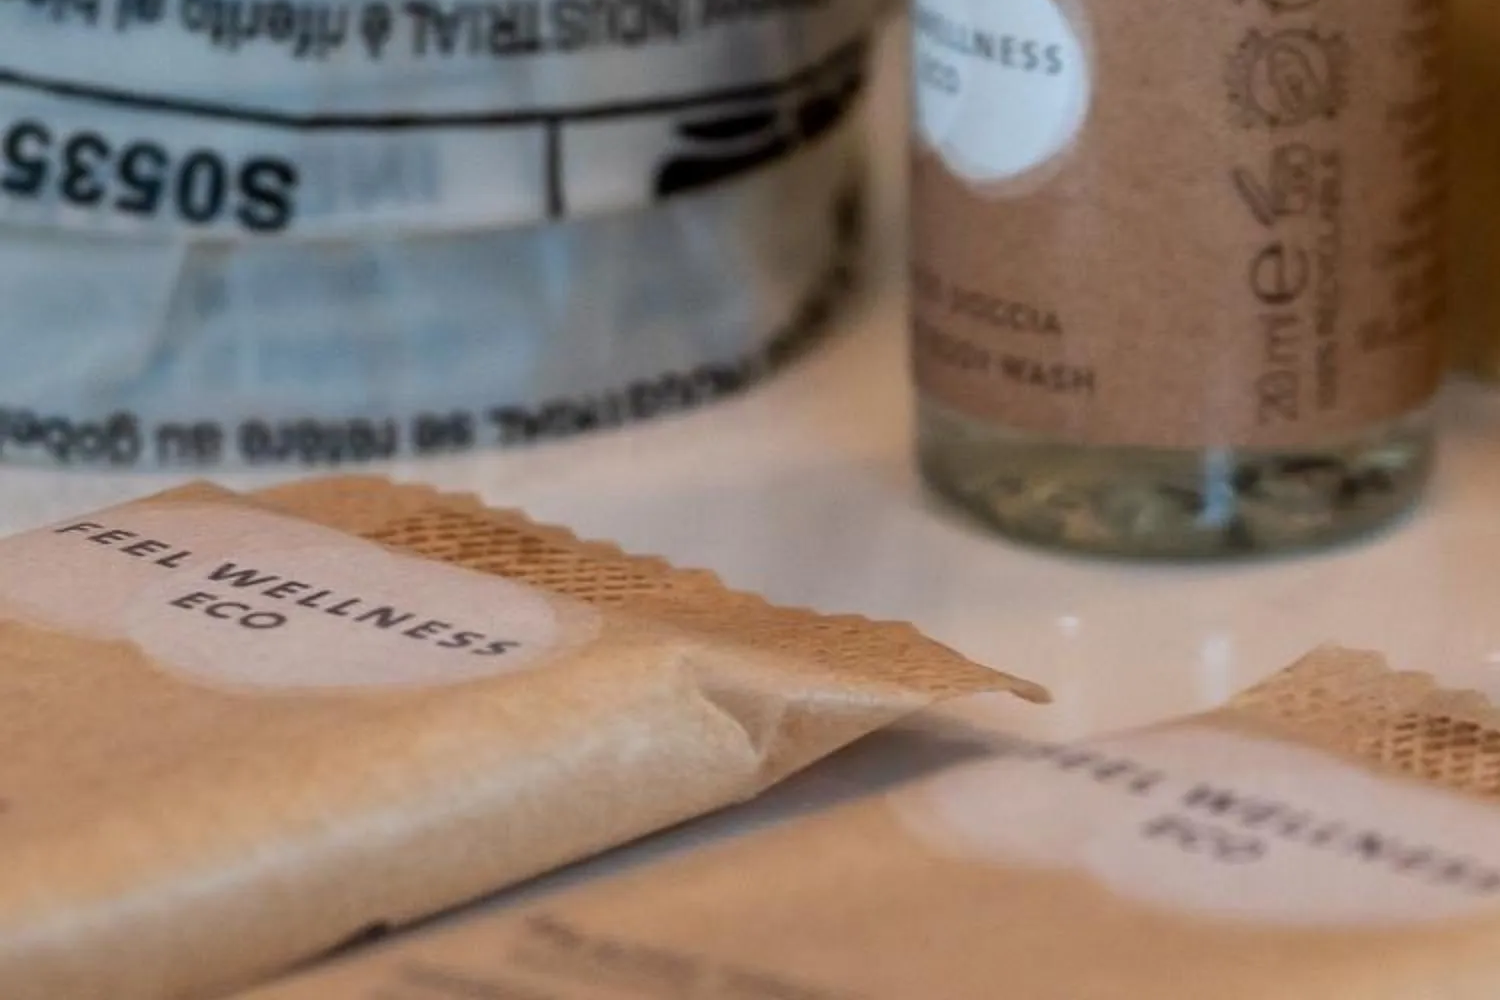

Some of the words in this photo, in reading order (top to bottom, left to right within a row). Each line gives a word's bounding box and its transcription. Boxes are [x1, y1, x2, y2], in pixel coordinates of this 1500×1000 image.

[0, 120, 299, 232] S0535
[54, 519, 193, 570] FEEL
[206, 561, 521, 659] WELLNESS
[169, 590, 287, 632] ECO
